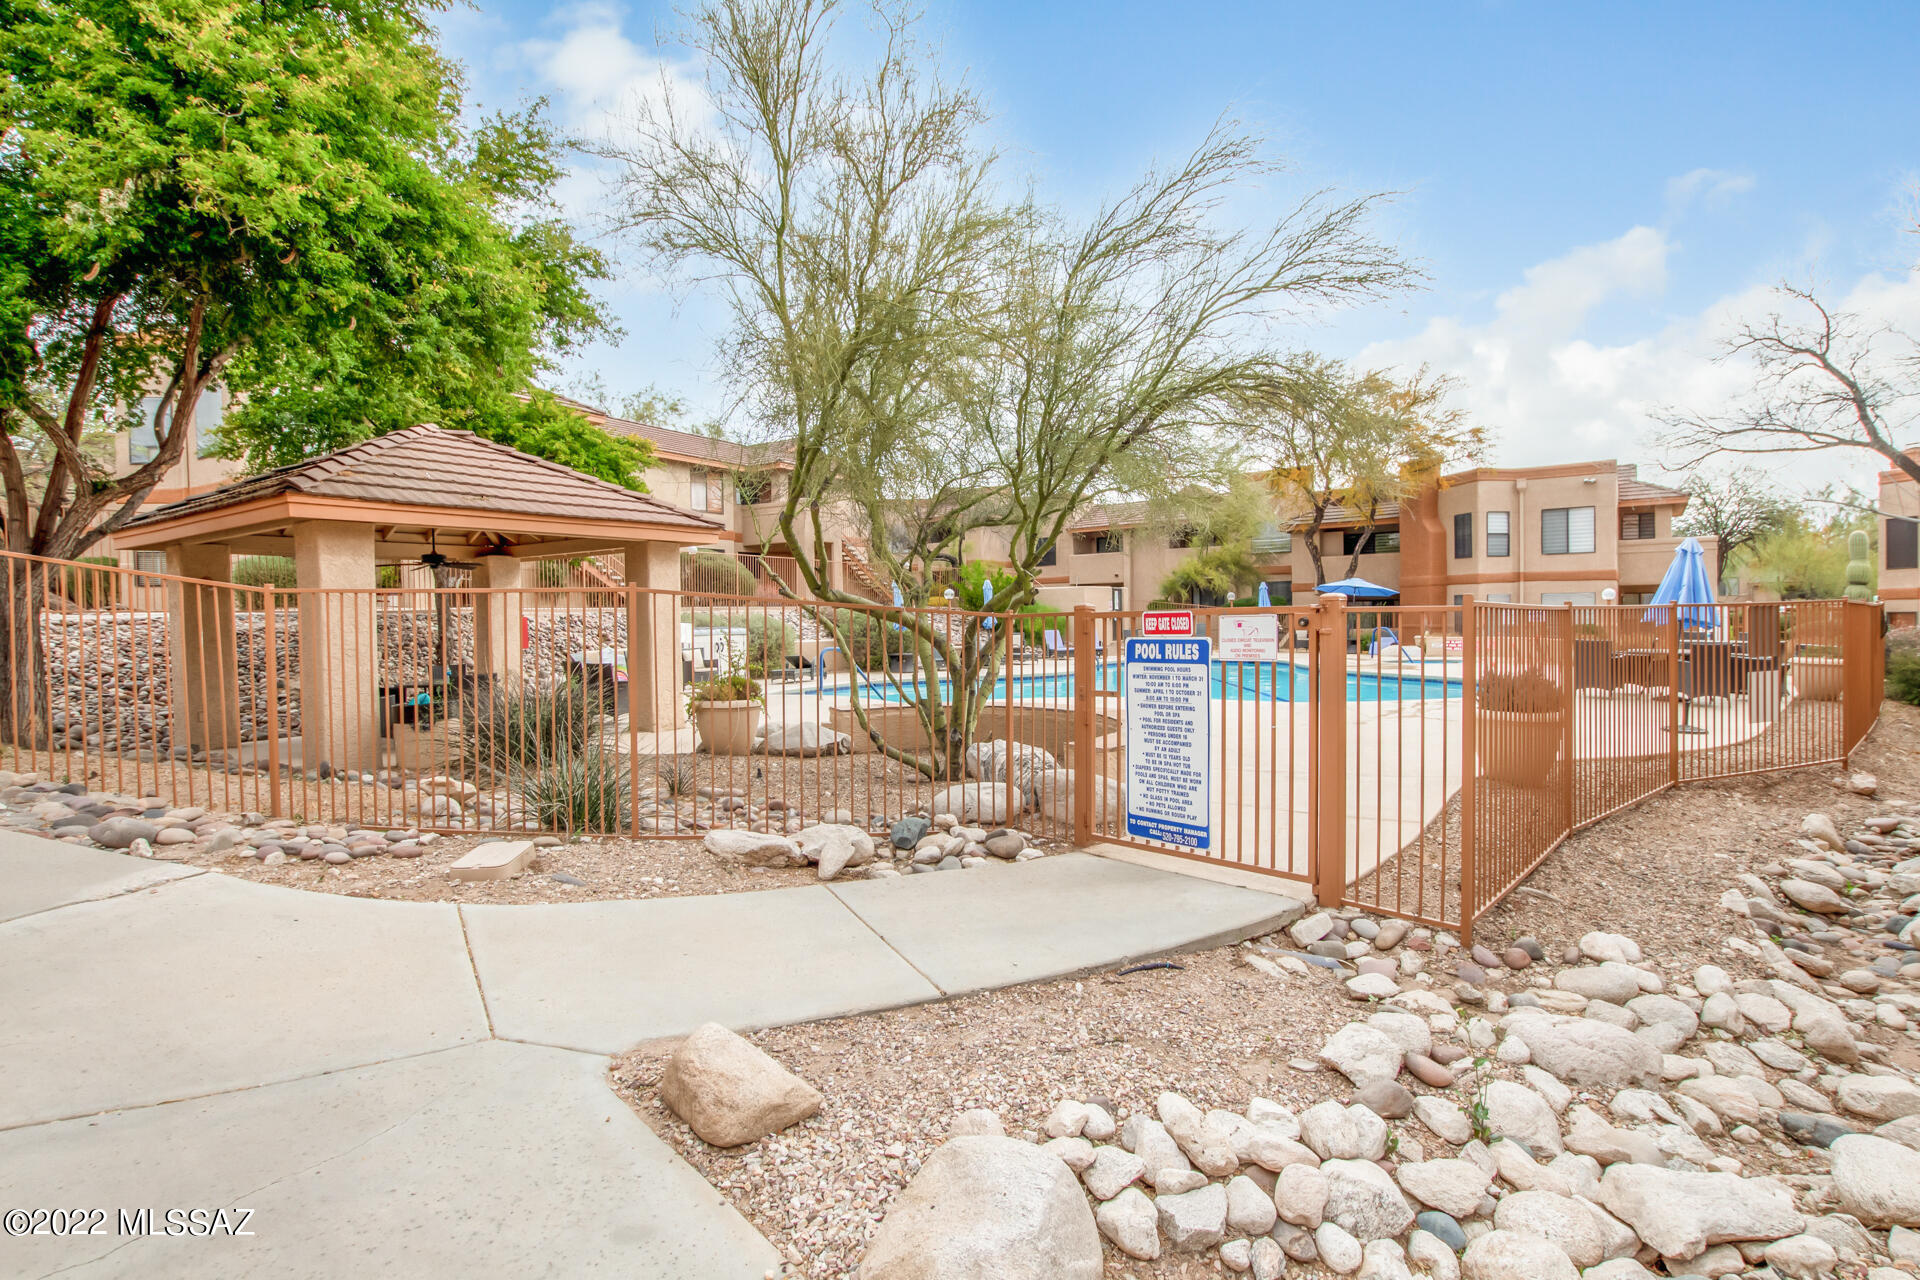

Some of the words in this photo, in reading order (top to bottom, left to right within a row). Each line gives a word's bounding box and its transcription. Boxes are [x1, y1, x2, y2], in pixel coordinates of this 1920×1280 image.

[1145, 618, 1157, 630] KEEP
[1158, 617, 1170, 630] GATE
[1171, 617, 1189, 630] CLOSED
[1135, 643, 1161, 659] POOL
[1165, 644, 1199, 660] RULES
[1137, 820, 1157, 828] CONTACT
[1158, 823, 1182, 832] PROPERTY
[1184, 828, 1207, 838] MANAGER
[1162, 832, 1197, 846] 520-795-2100
